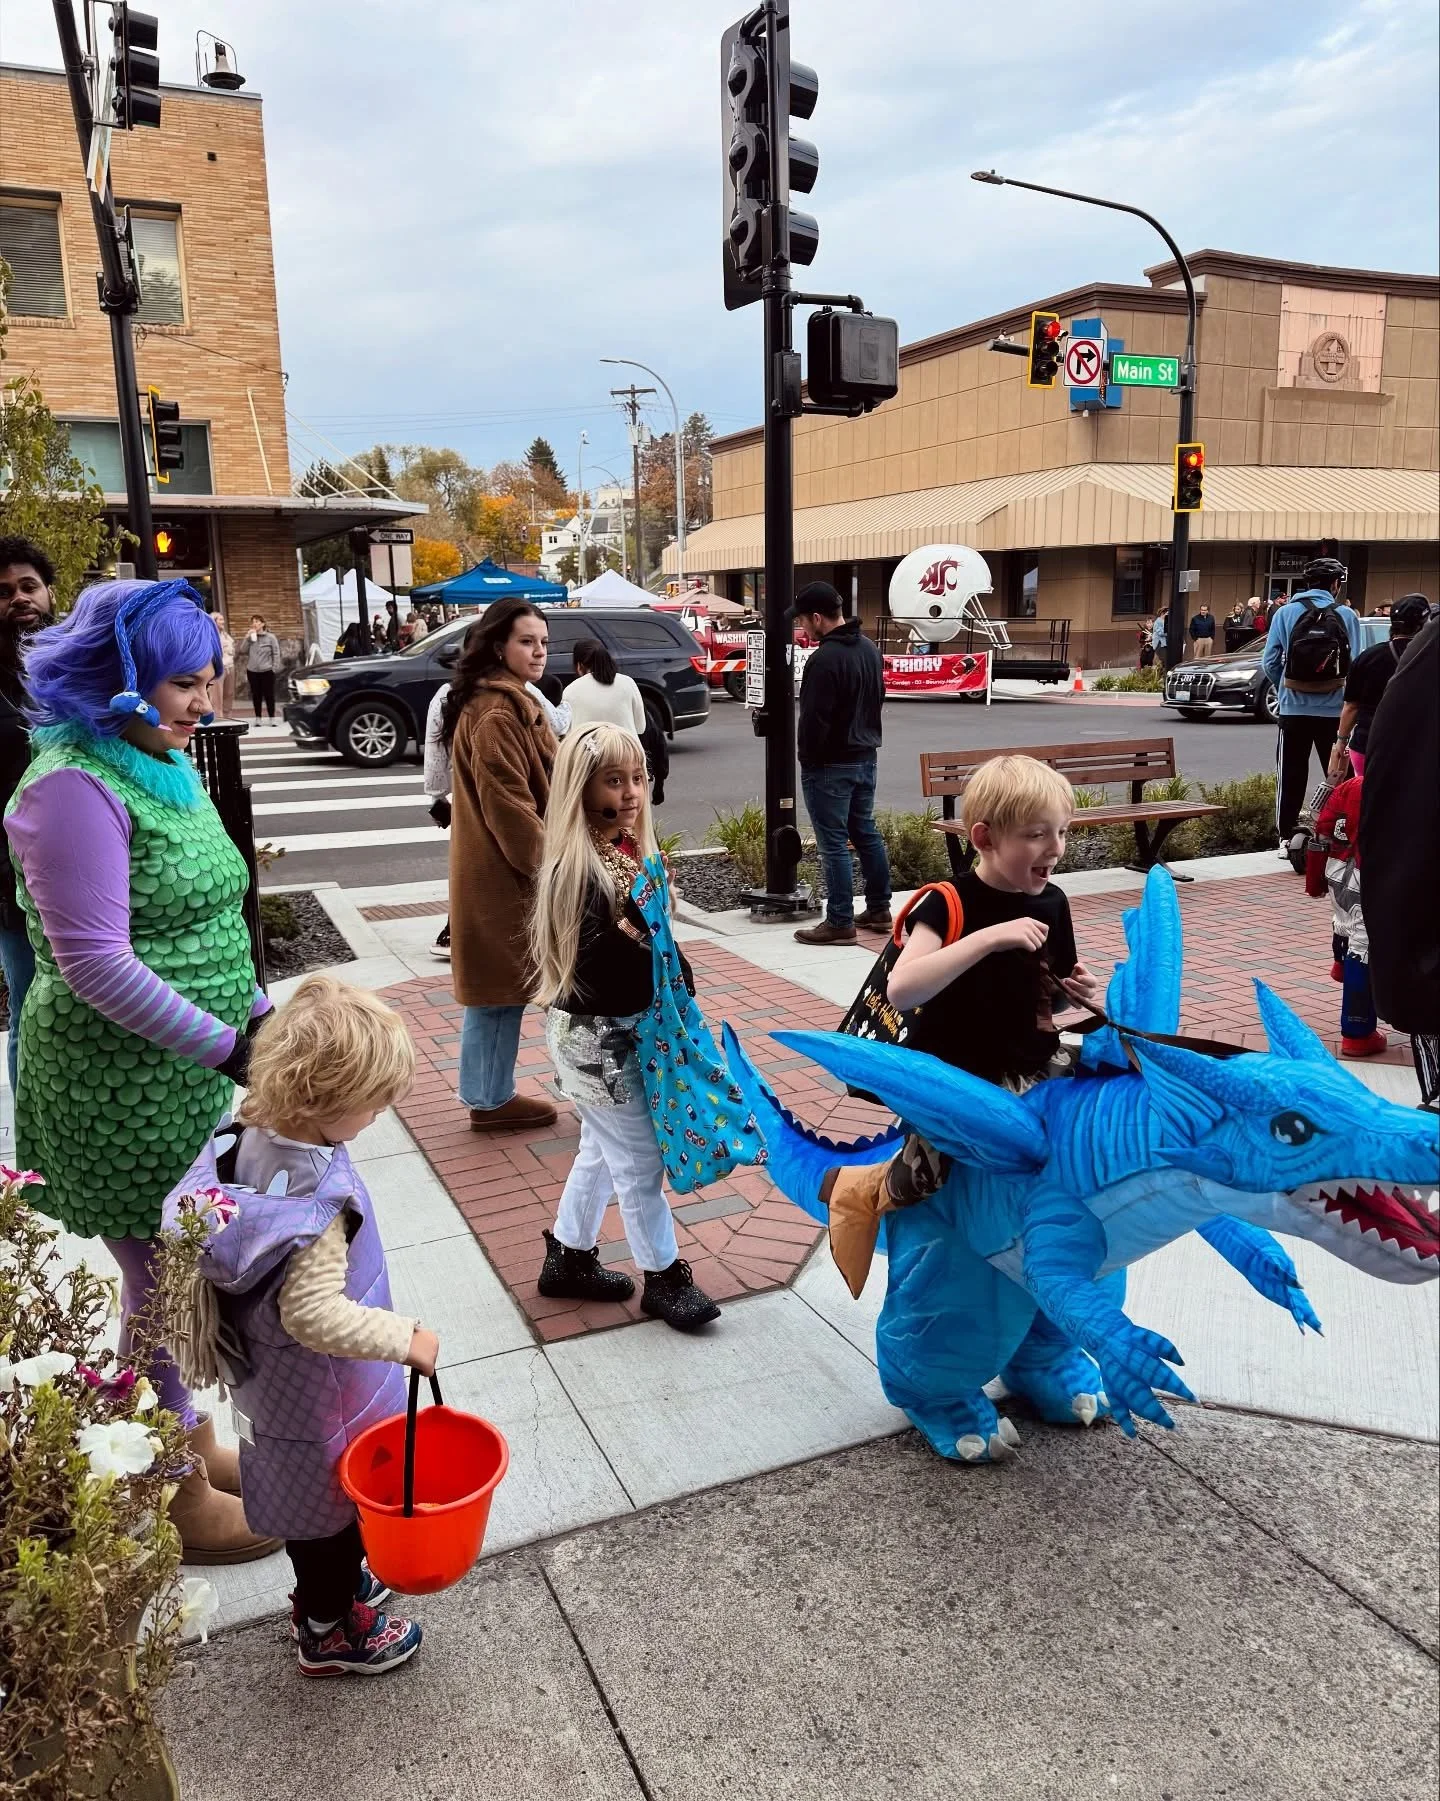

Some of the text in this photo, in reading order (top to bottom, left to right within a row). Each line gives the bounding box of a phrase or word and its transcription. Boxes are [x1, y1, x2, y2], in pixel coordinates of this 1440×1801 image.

[1117, 360, 1173, 381] Main St
[715, 633, 747, 644] WASHIN
[892, 657, 943, 672] FRIDAY
